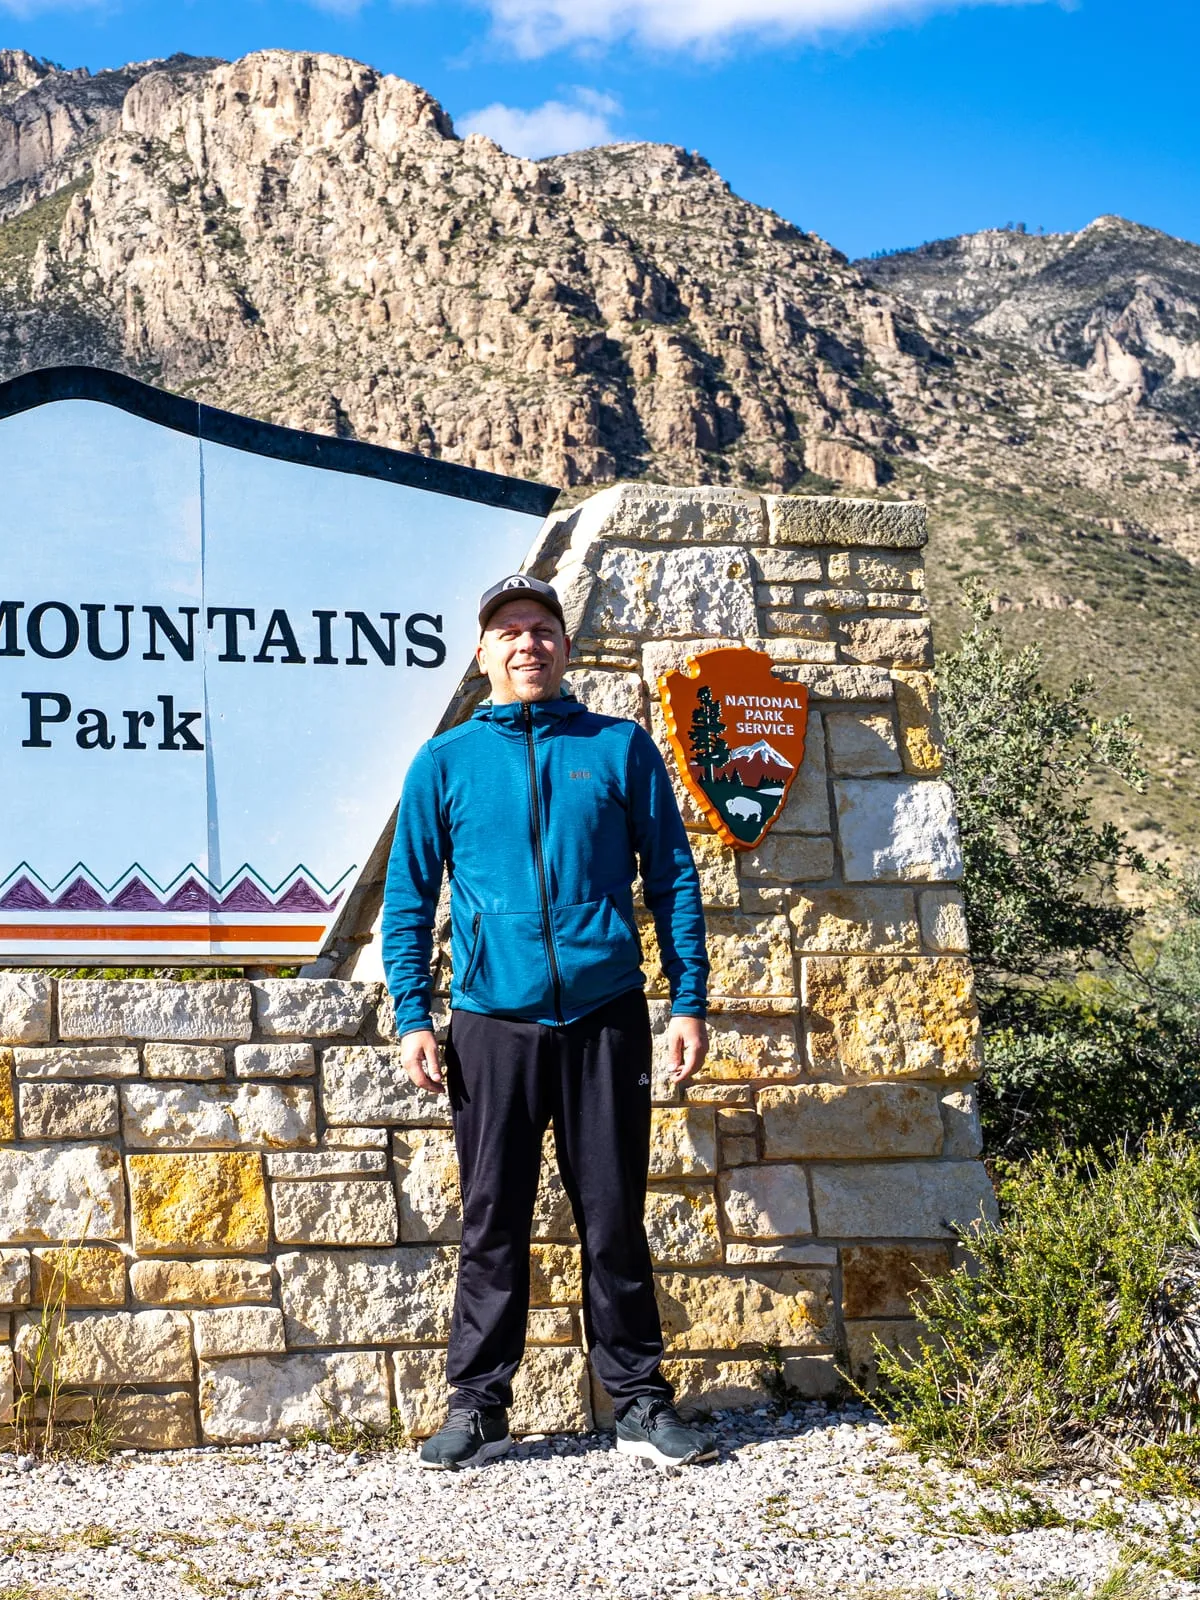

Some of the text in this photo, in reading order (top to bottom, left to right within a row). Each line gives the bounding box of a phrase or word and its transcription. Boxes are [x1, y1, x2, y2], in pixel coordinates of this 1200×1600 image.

[725, 694, 802, 709] NATIONAL
[22, 692, 204, 750] Park
[745, 709, 784, 722] PARK
[736, 722, 795, 736] SERVICE
